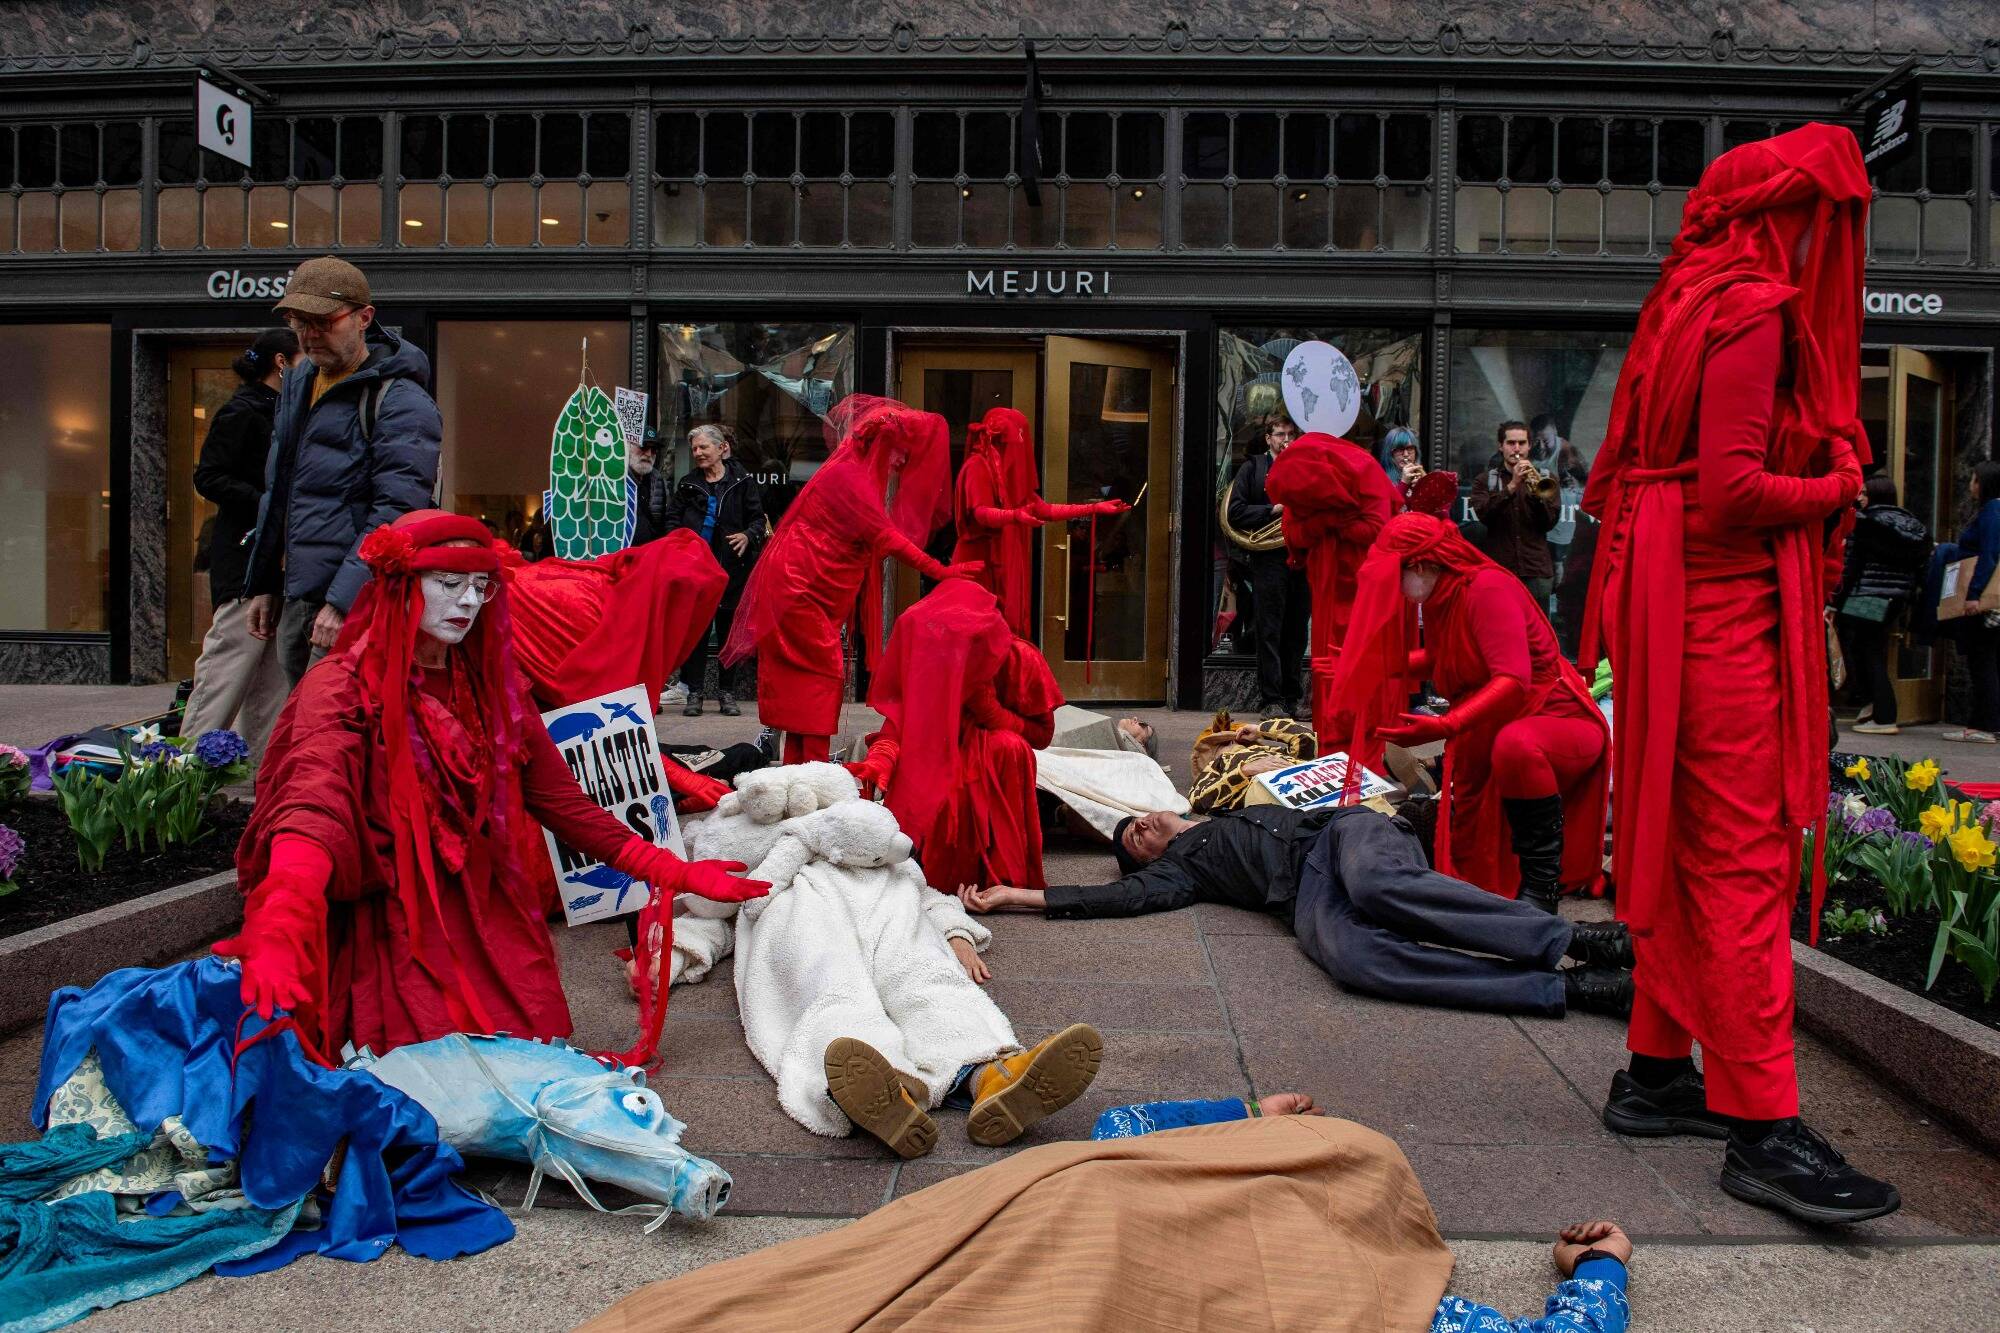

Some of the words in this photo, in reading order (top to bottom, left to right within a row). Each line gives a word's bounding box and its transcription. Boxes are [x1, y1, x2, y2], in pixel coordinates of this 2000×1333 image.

[967, 270, 1109, 296] MEJURI
[750, 472, 786, 485] URI
[1293, 761, 1349, 789] PLASTI
